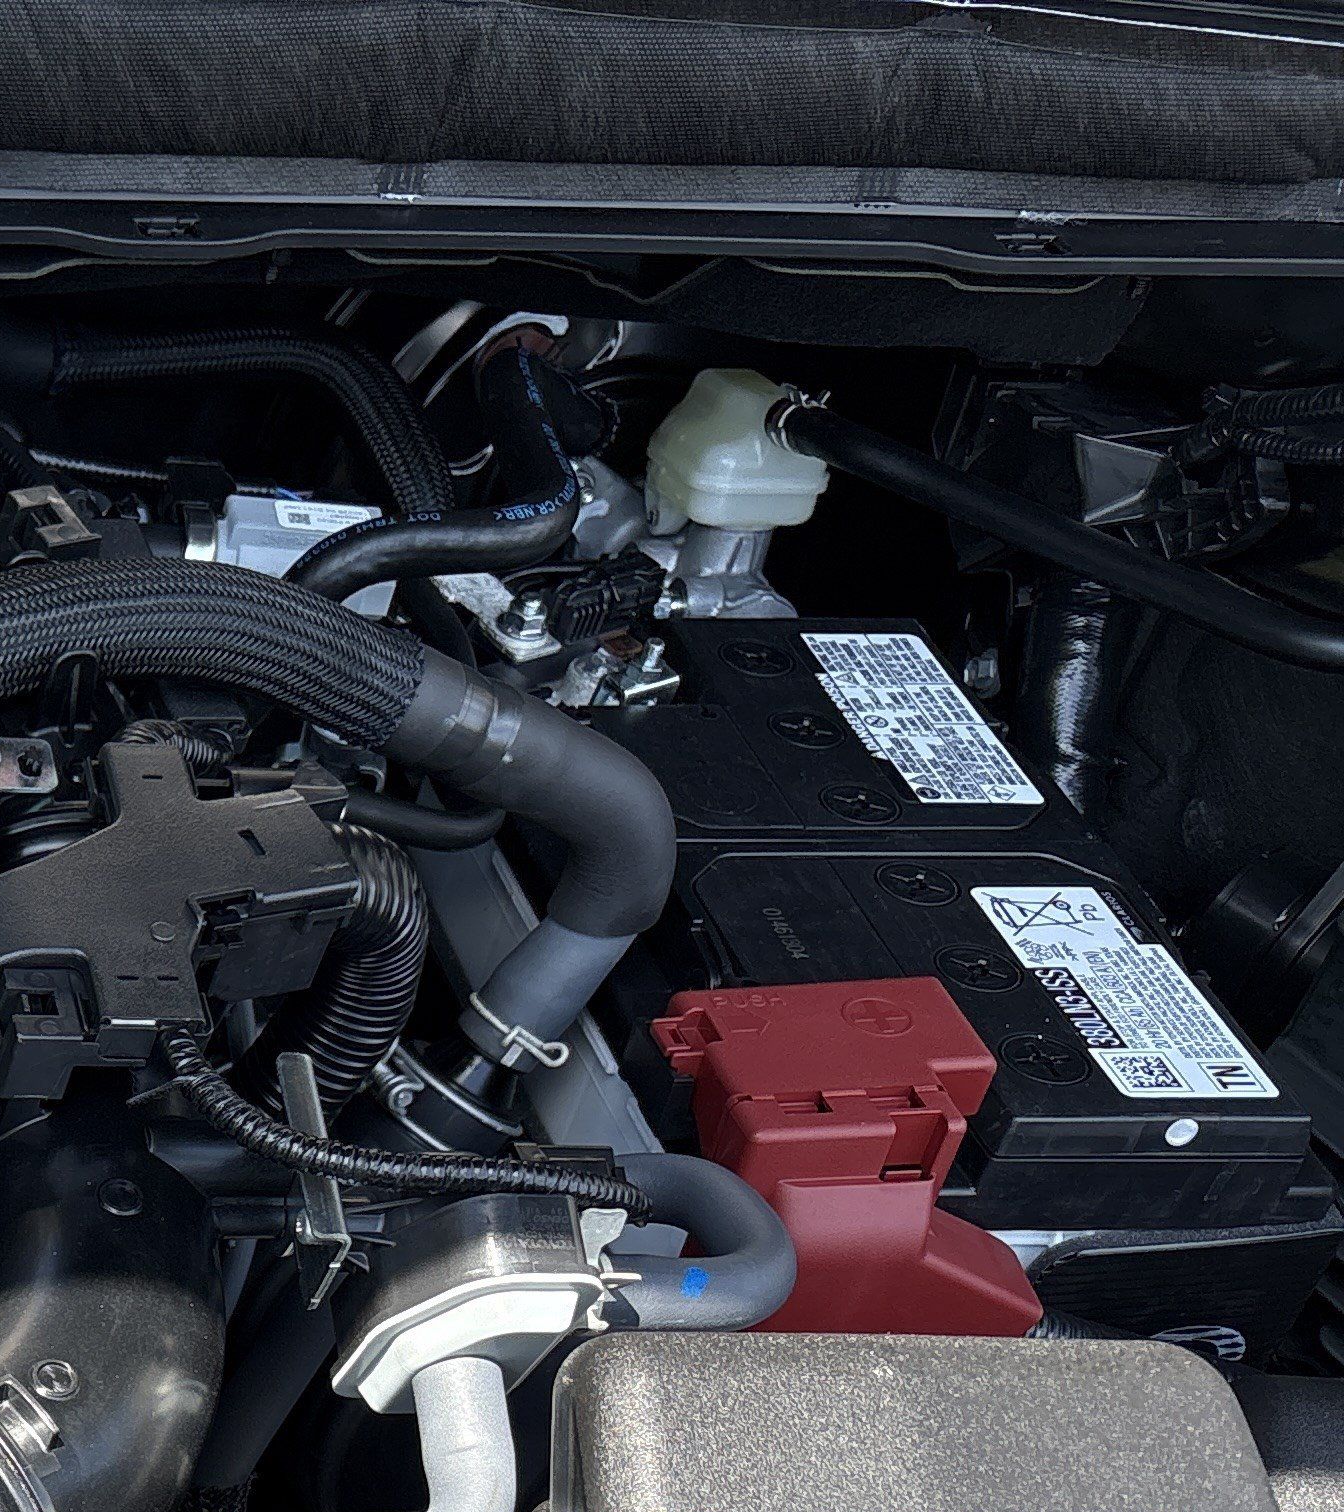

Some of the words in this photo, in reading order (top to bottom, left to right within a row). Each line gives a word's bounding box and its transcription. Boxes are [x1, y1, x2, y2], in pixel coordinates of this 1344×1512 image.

[1078, 902, 1106, 921] Pb
[1035, 969, 1120, 1047] 380LN3-ISS
[1205, 1064, 1257, 1091] TN
